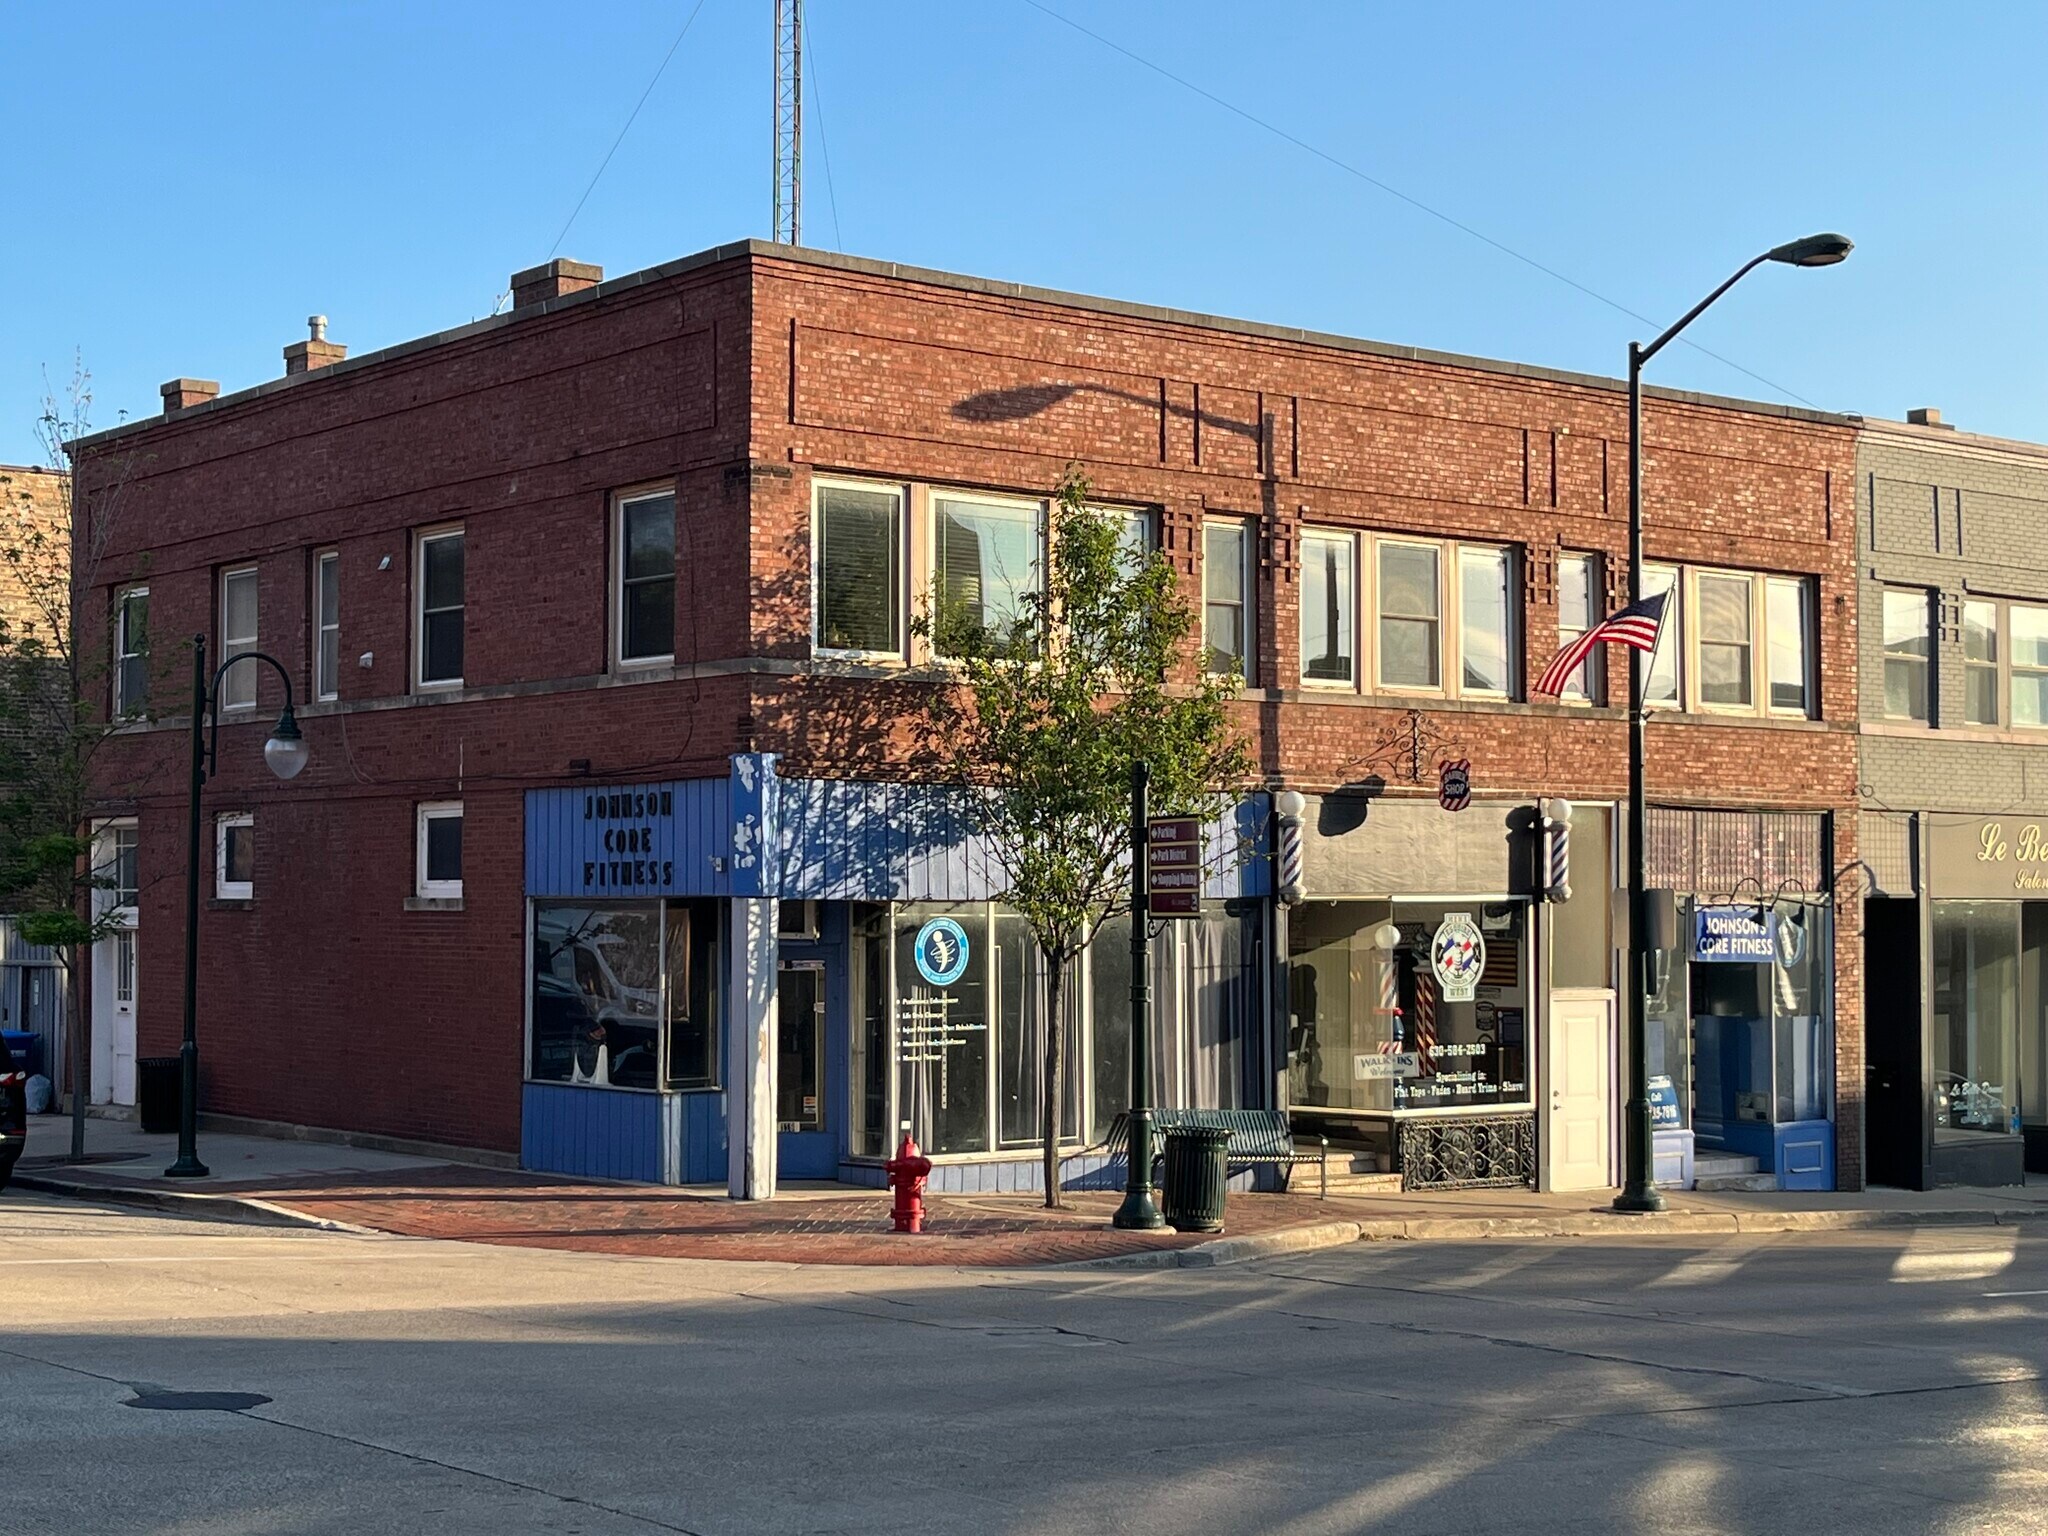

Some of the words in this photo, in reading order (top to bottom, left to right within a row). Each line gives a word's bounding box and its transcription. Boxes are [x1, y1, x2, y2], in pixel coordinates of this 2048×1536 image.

[1444, 783, 1466, 795] SHOP
[584, 791, 672, 820] JOHNSON
[604, 828, 652, 854] CORE
[1157, 825, 1177, 840] Parking
[1977, 823, 2007, 861] Le
[1157, 849, 1169, 861] Park
[1169, 848, 1187, 861] District
[584, 860, 673, 886] FITNESS
[1699, 937, 1729, 954] CORE
[1731, 938, 1773, 955] FITNESS
[1449, 987, 1469, 996] WEST
[1394, 1087, 1409, 1098] Flat
[1410, 1086, 1426, 1098] Tops
[1431, 1085, 1451, 1096] Fades
[1456, 1083, 1476, 1094] Beard
[1478, 1082, 1497, 1093] Trims
